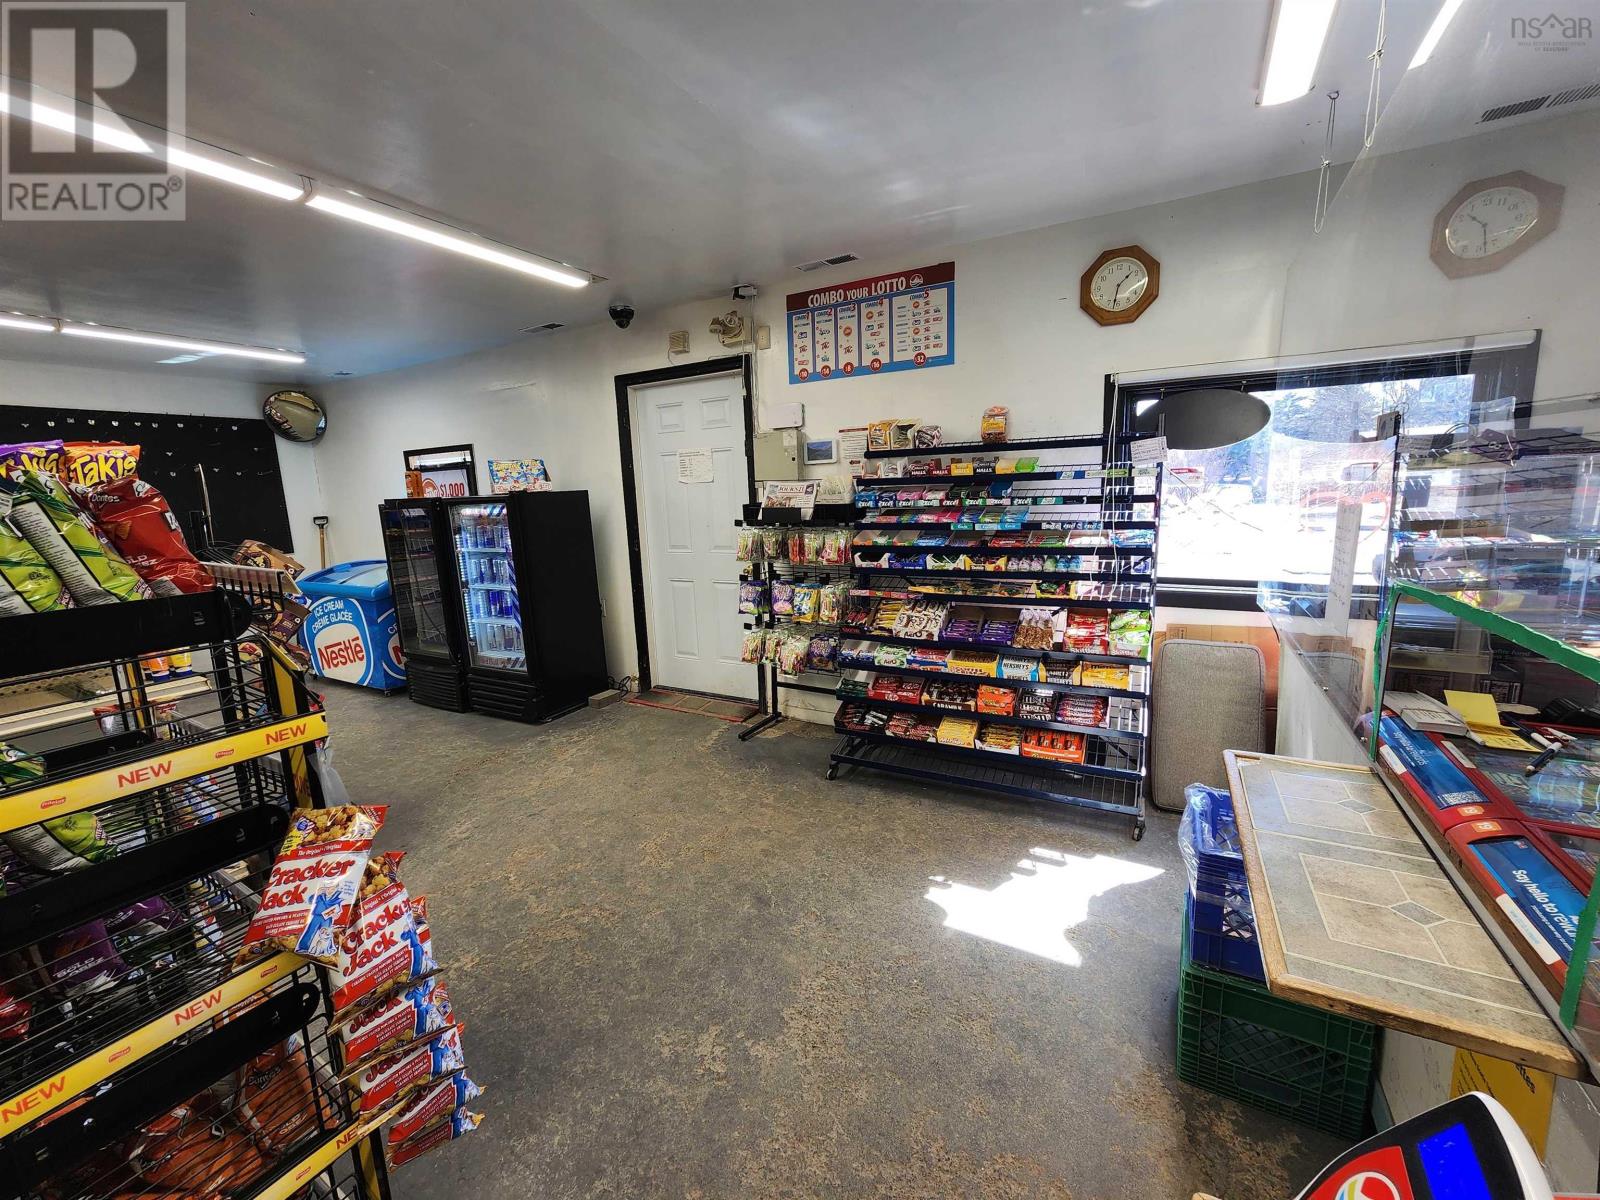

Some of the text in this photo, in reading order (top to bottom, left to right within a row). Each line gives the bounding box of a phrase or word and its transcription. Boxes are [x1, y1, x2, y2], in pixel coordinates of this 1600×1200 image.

[808, 276, 906, 307] COMBO YOUR LOTTO
[71, 454, 137, 488] Takis
[314, 600, 344, 617] ICE CREAM
[265, 723, 307, 745] NEW
[117, 760, 173, 788] NEW
[269, 858, 356, 888] Cracker
[257, 885, 309, 914] Jack
[1513, 869, 1530, 886] Say
[1525, 883, 1549, 903] hello
[1542, 901, 1559, 914] to
[343, 929, 398, 977] Jack
[174, 990, 223, 1026] NEW
[1, 1076, 66, 1123] NEW
